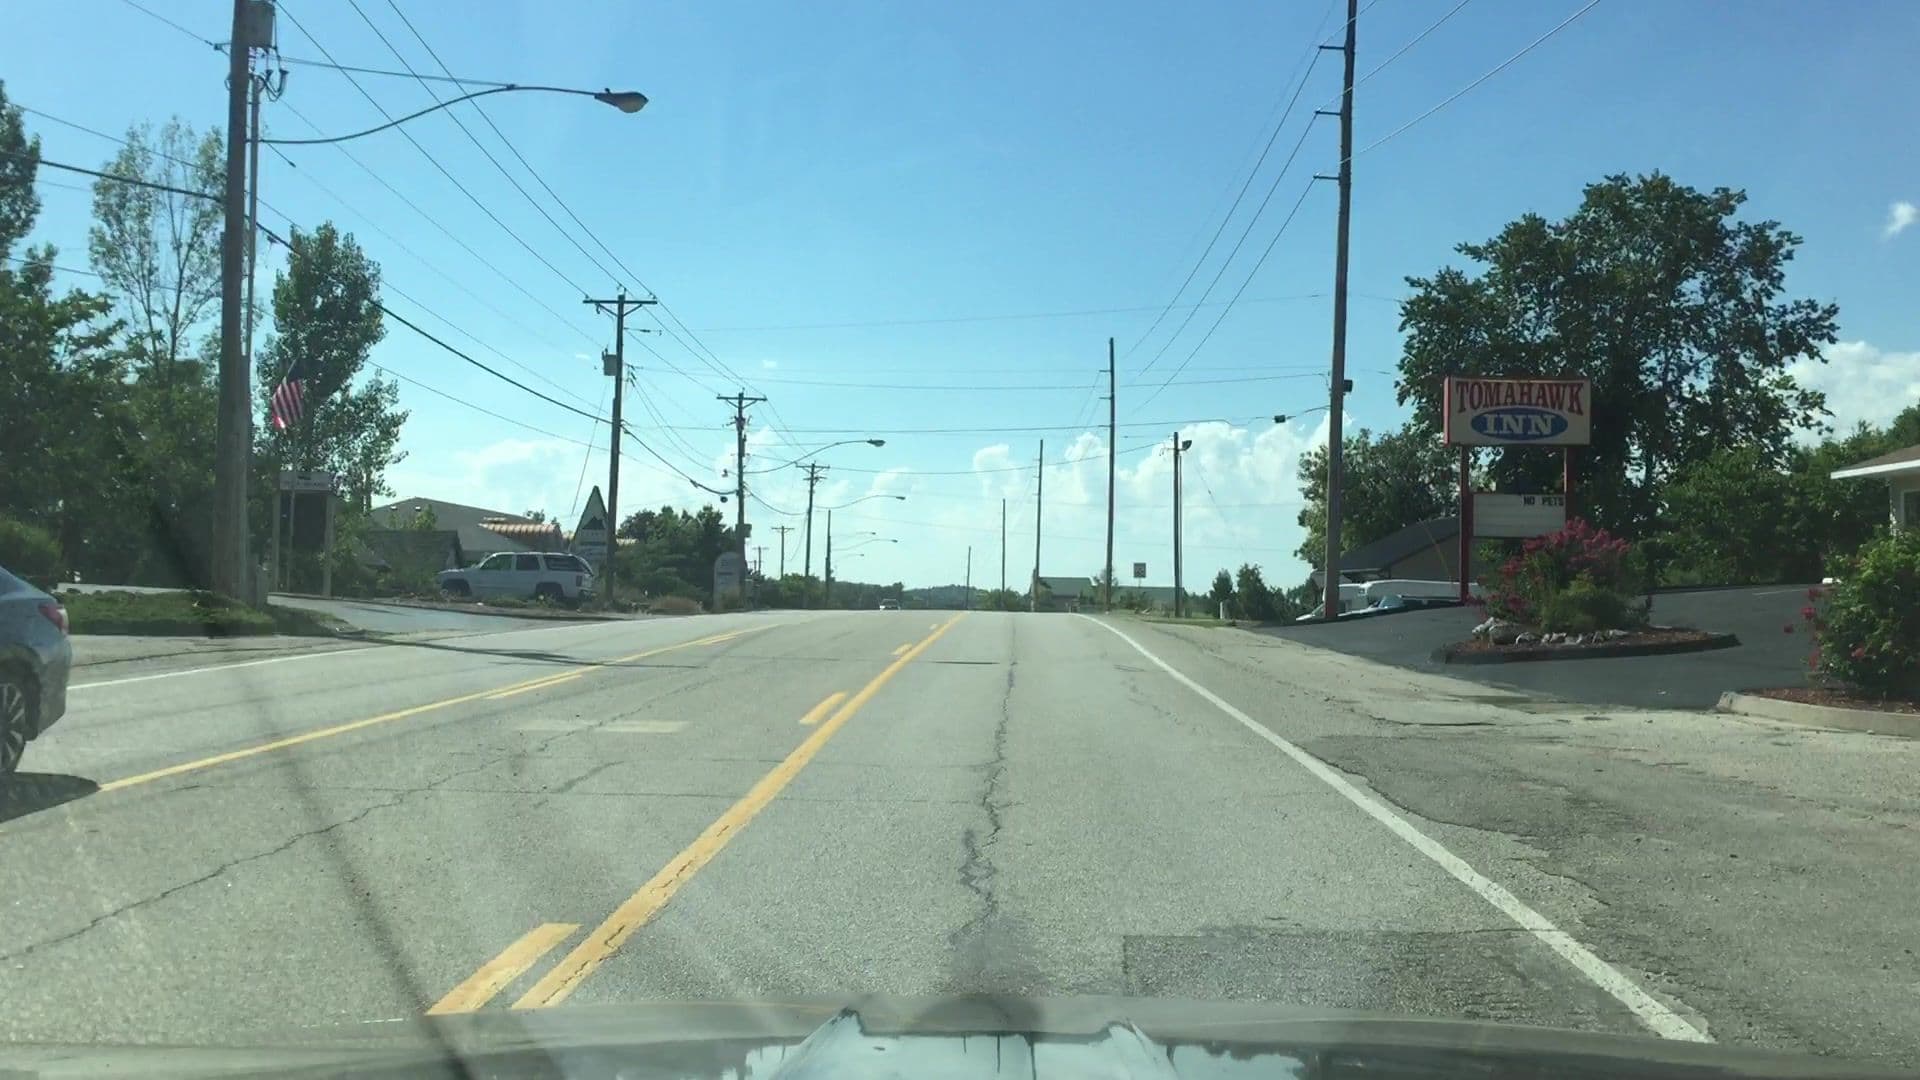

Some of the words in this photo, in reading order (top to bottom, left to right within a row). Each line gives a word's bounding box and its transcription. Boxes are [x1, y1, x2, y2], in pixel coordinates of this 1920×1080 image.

[1456, 381, 1584, 416] TOMAHAWK
[1483, 414, 1555, 435] INN
[1523, 496, 1536, 506] NO
[1542, 496, 1564, 507] PETS
